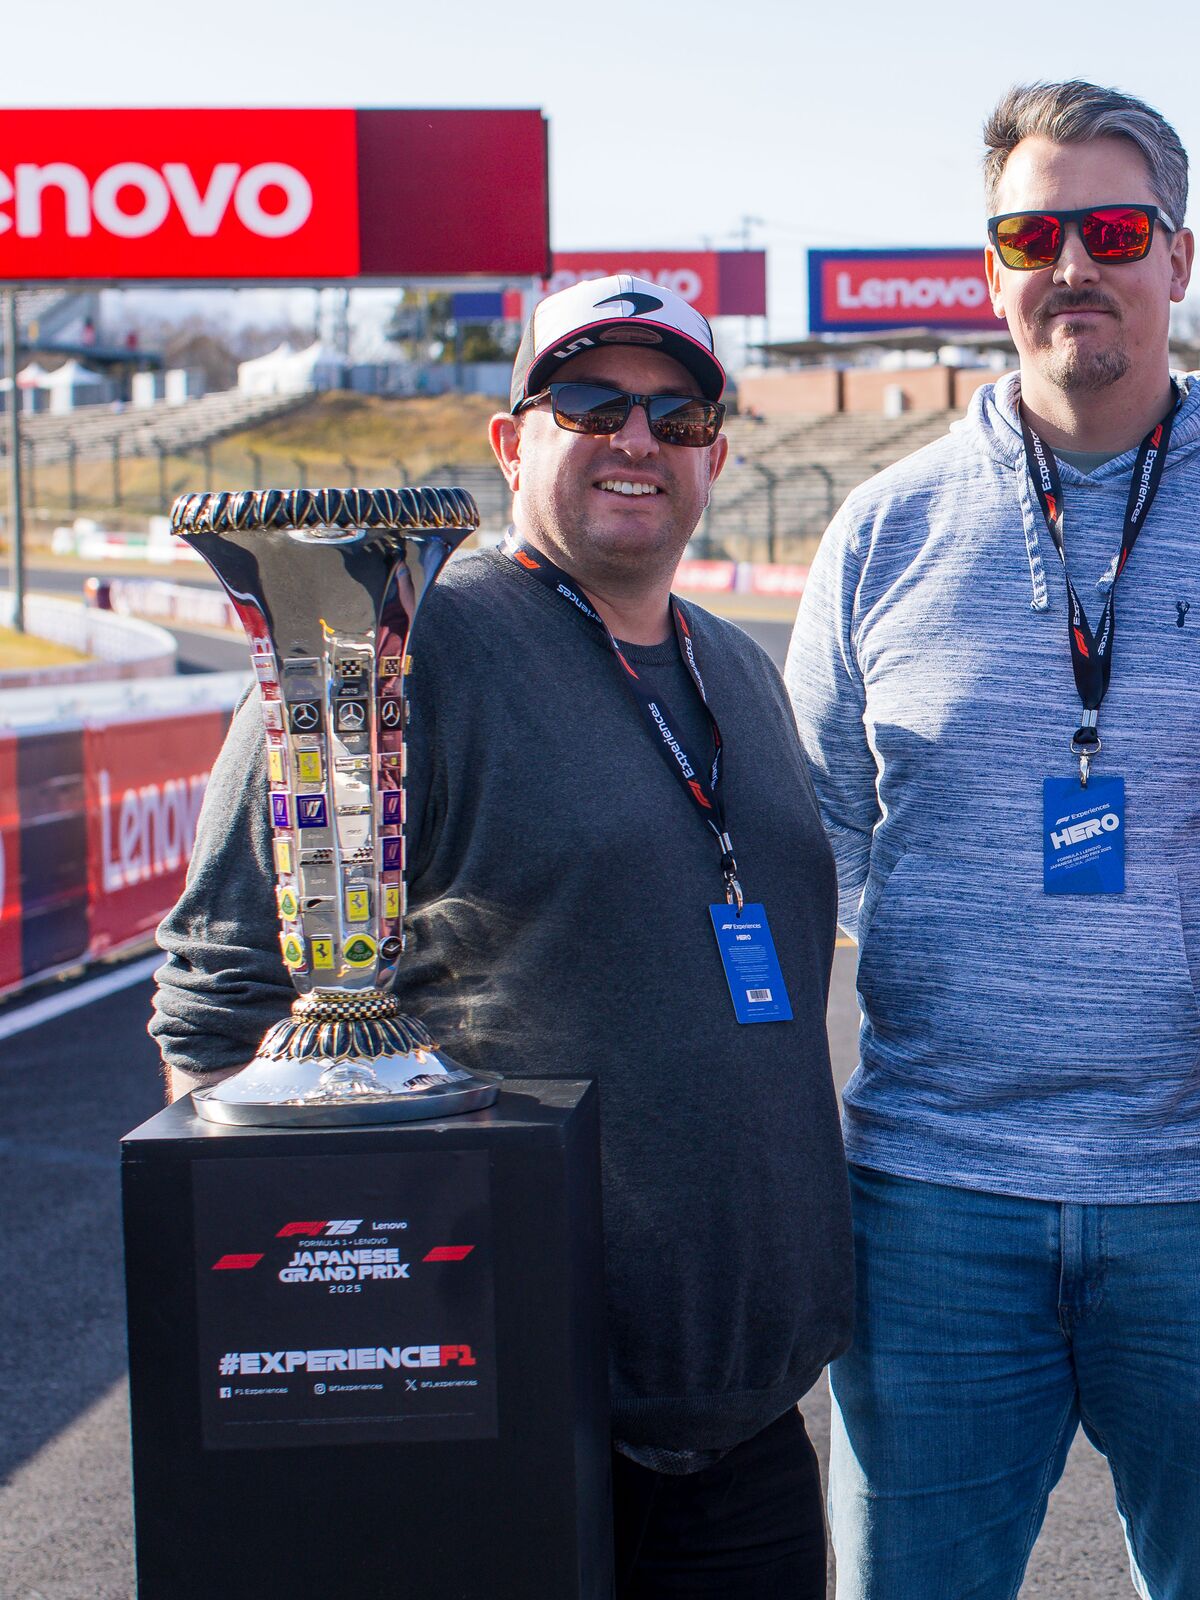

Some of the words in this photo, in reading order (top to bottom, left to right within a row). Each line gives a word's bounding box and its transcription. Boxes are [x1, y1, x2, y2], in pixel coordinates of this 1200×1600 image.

[0, 162, 312, 238] novo
[837, 271, 986, 309] Lenovo
[1130, 449, 1158, 524] Experiences
[648, 702, 695, 779] Experiences
[1071, 803, 1111, 819] Experiences
[99, 770, 209, 893] Lenov
[1050, 813, 1120, 850] HERO
[275, 1221, 328, 1238] F1
[372, 1222, 408, 1231] Lenovo
[279, 1266, 357, 1283] GRAND
[358, 1264, 411, 1280] PRIX
[289, 1248, 400, 1267] JAPANESE
[328, 1284, 362, 1294] 2025
[218, 1344, 477, 1376] #EXPERIENCEF1
